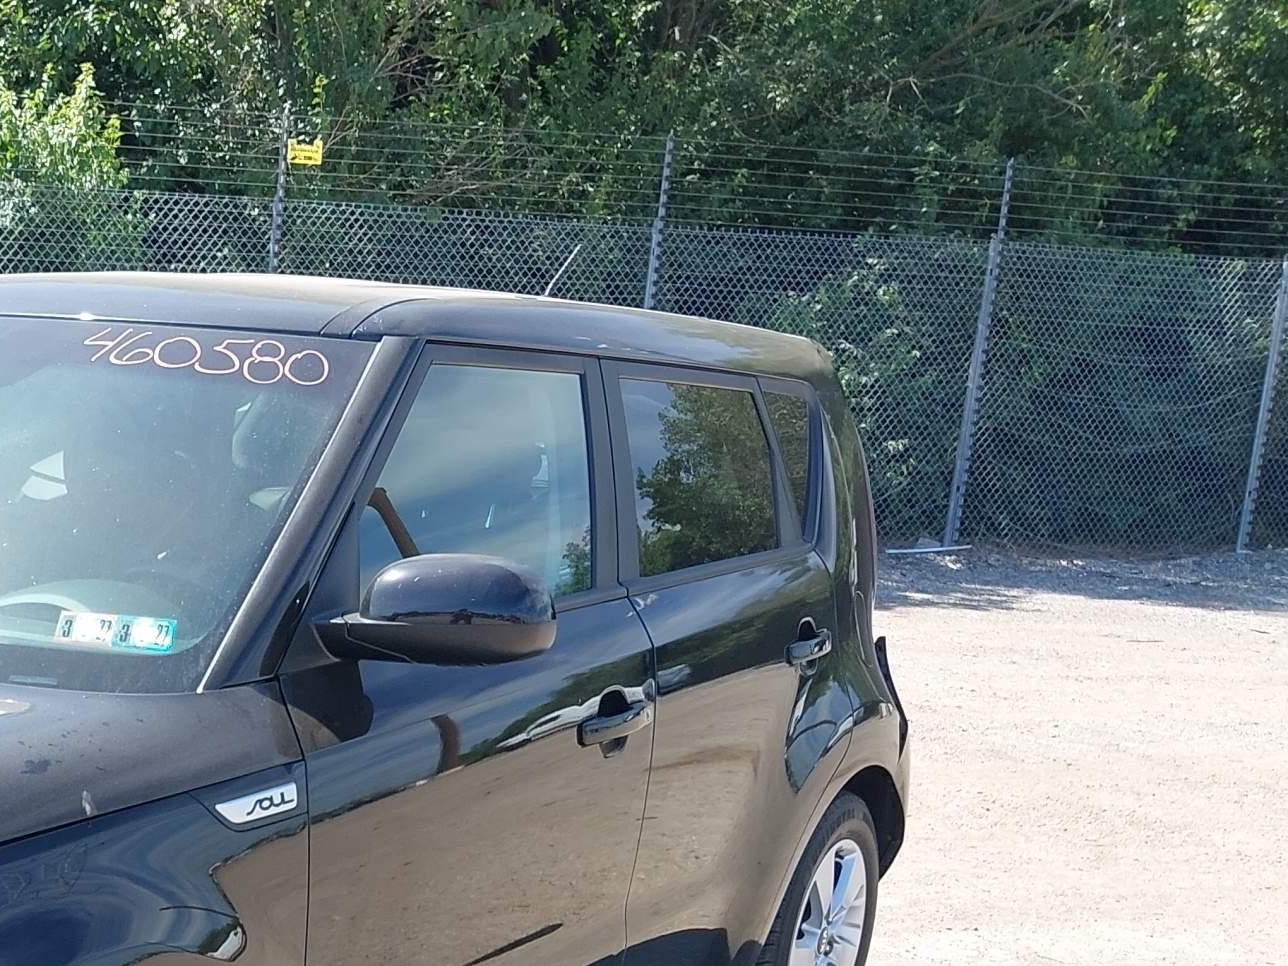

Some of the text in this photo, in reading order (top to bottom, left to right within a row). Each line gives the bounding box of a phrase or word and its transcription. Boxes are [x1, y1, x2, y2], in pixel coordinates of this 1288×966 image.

[83, 327, 329, 386] 460580
[62, 619, 73, 638] 3
[119, 623, 131, 643] 3
